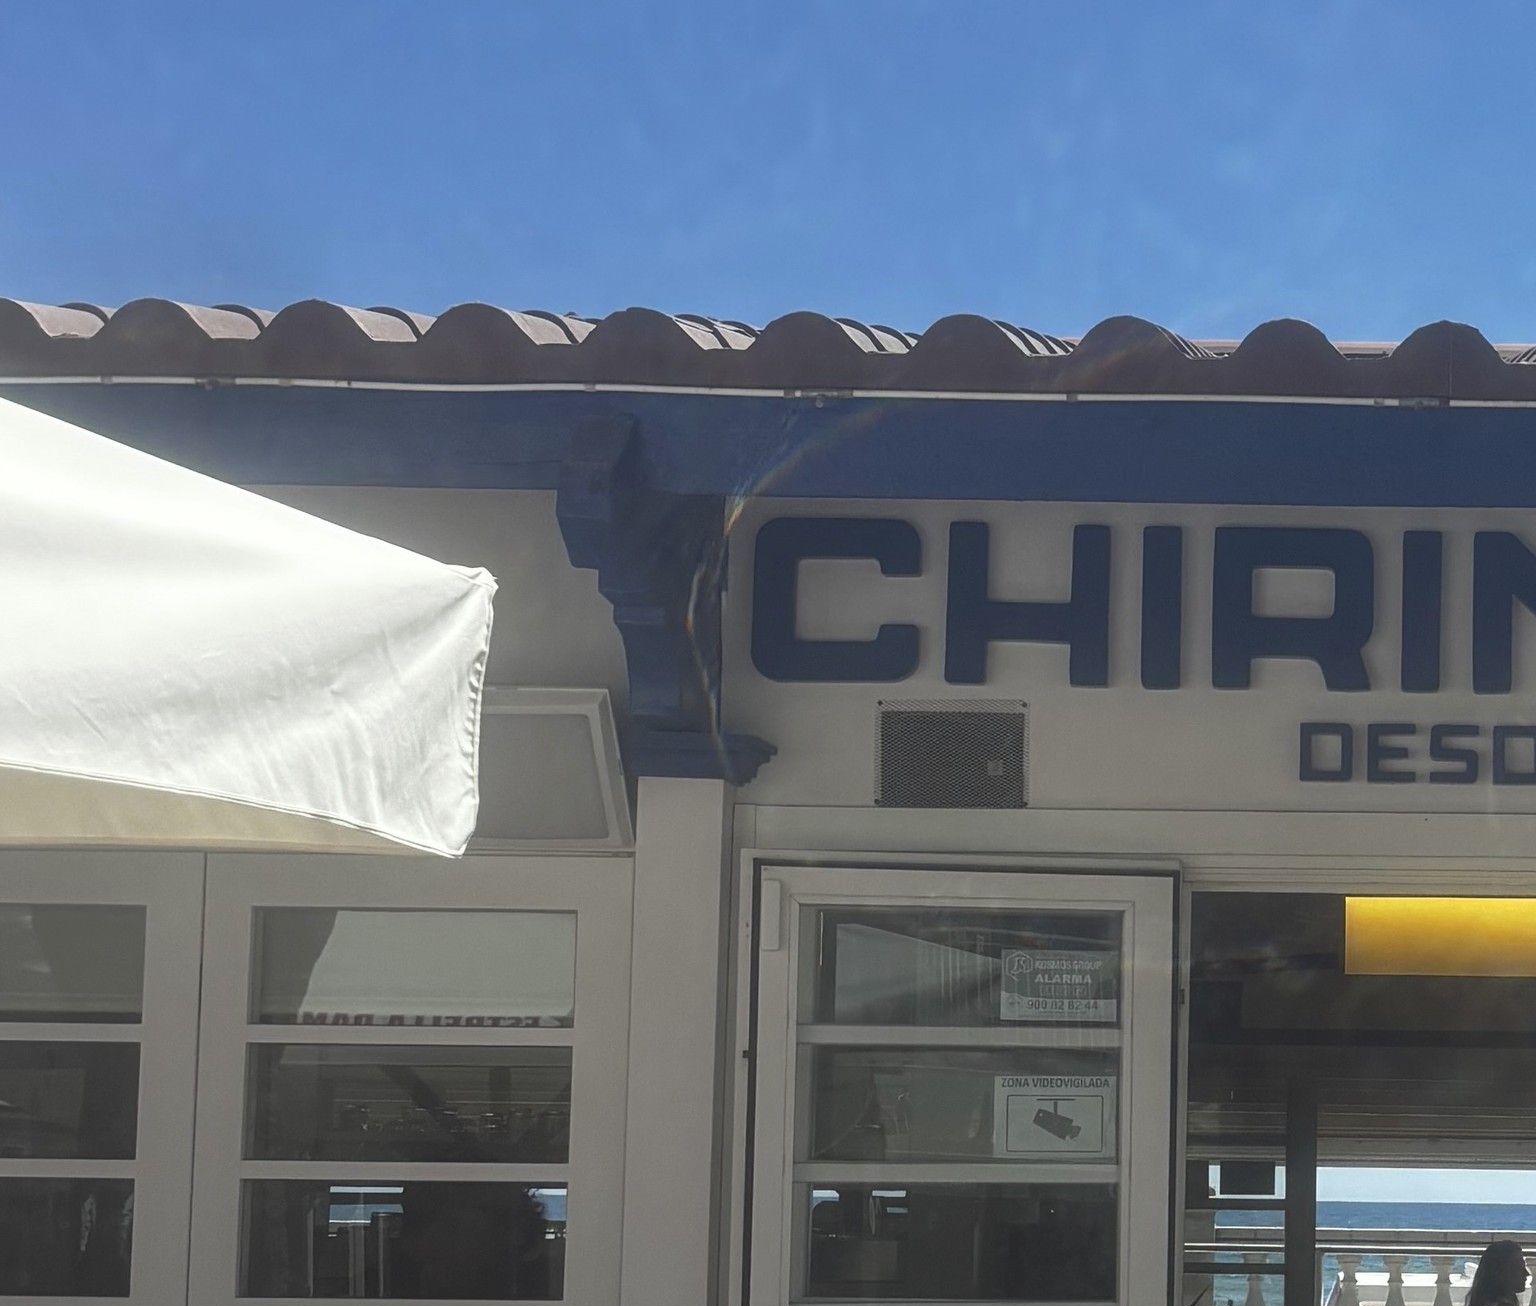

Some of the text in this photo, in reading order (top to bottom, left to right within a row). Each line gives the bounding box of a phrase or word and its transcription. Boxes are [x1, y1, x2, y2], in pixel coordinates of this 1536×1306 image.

[1034, 973, 1092, 984] ALARMA
[1027, 999, 1047, 1010] 900
[1084, 1001, 1098, 1011] 44
[1001, 1077, 1110, 1089] ZONA VIDEOVIGILADA
